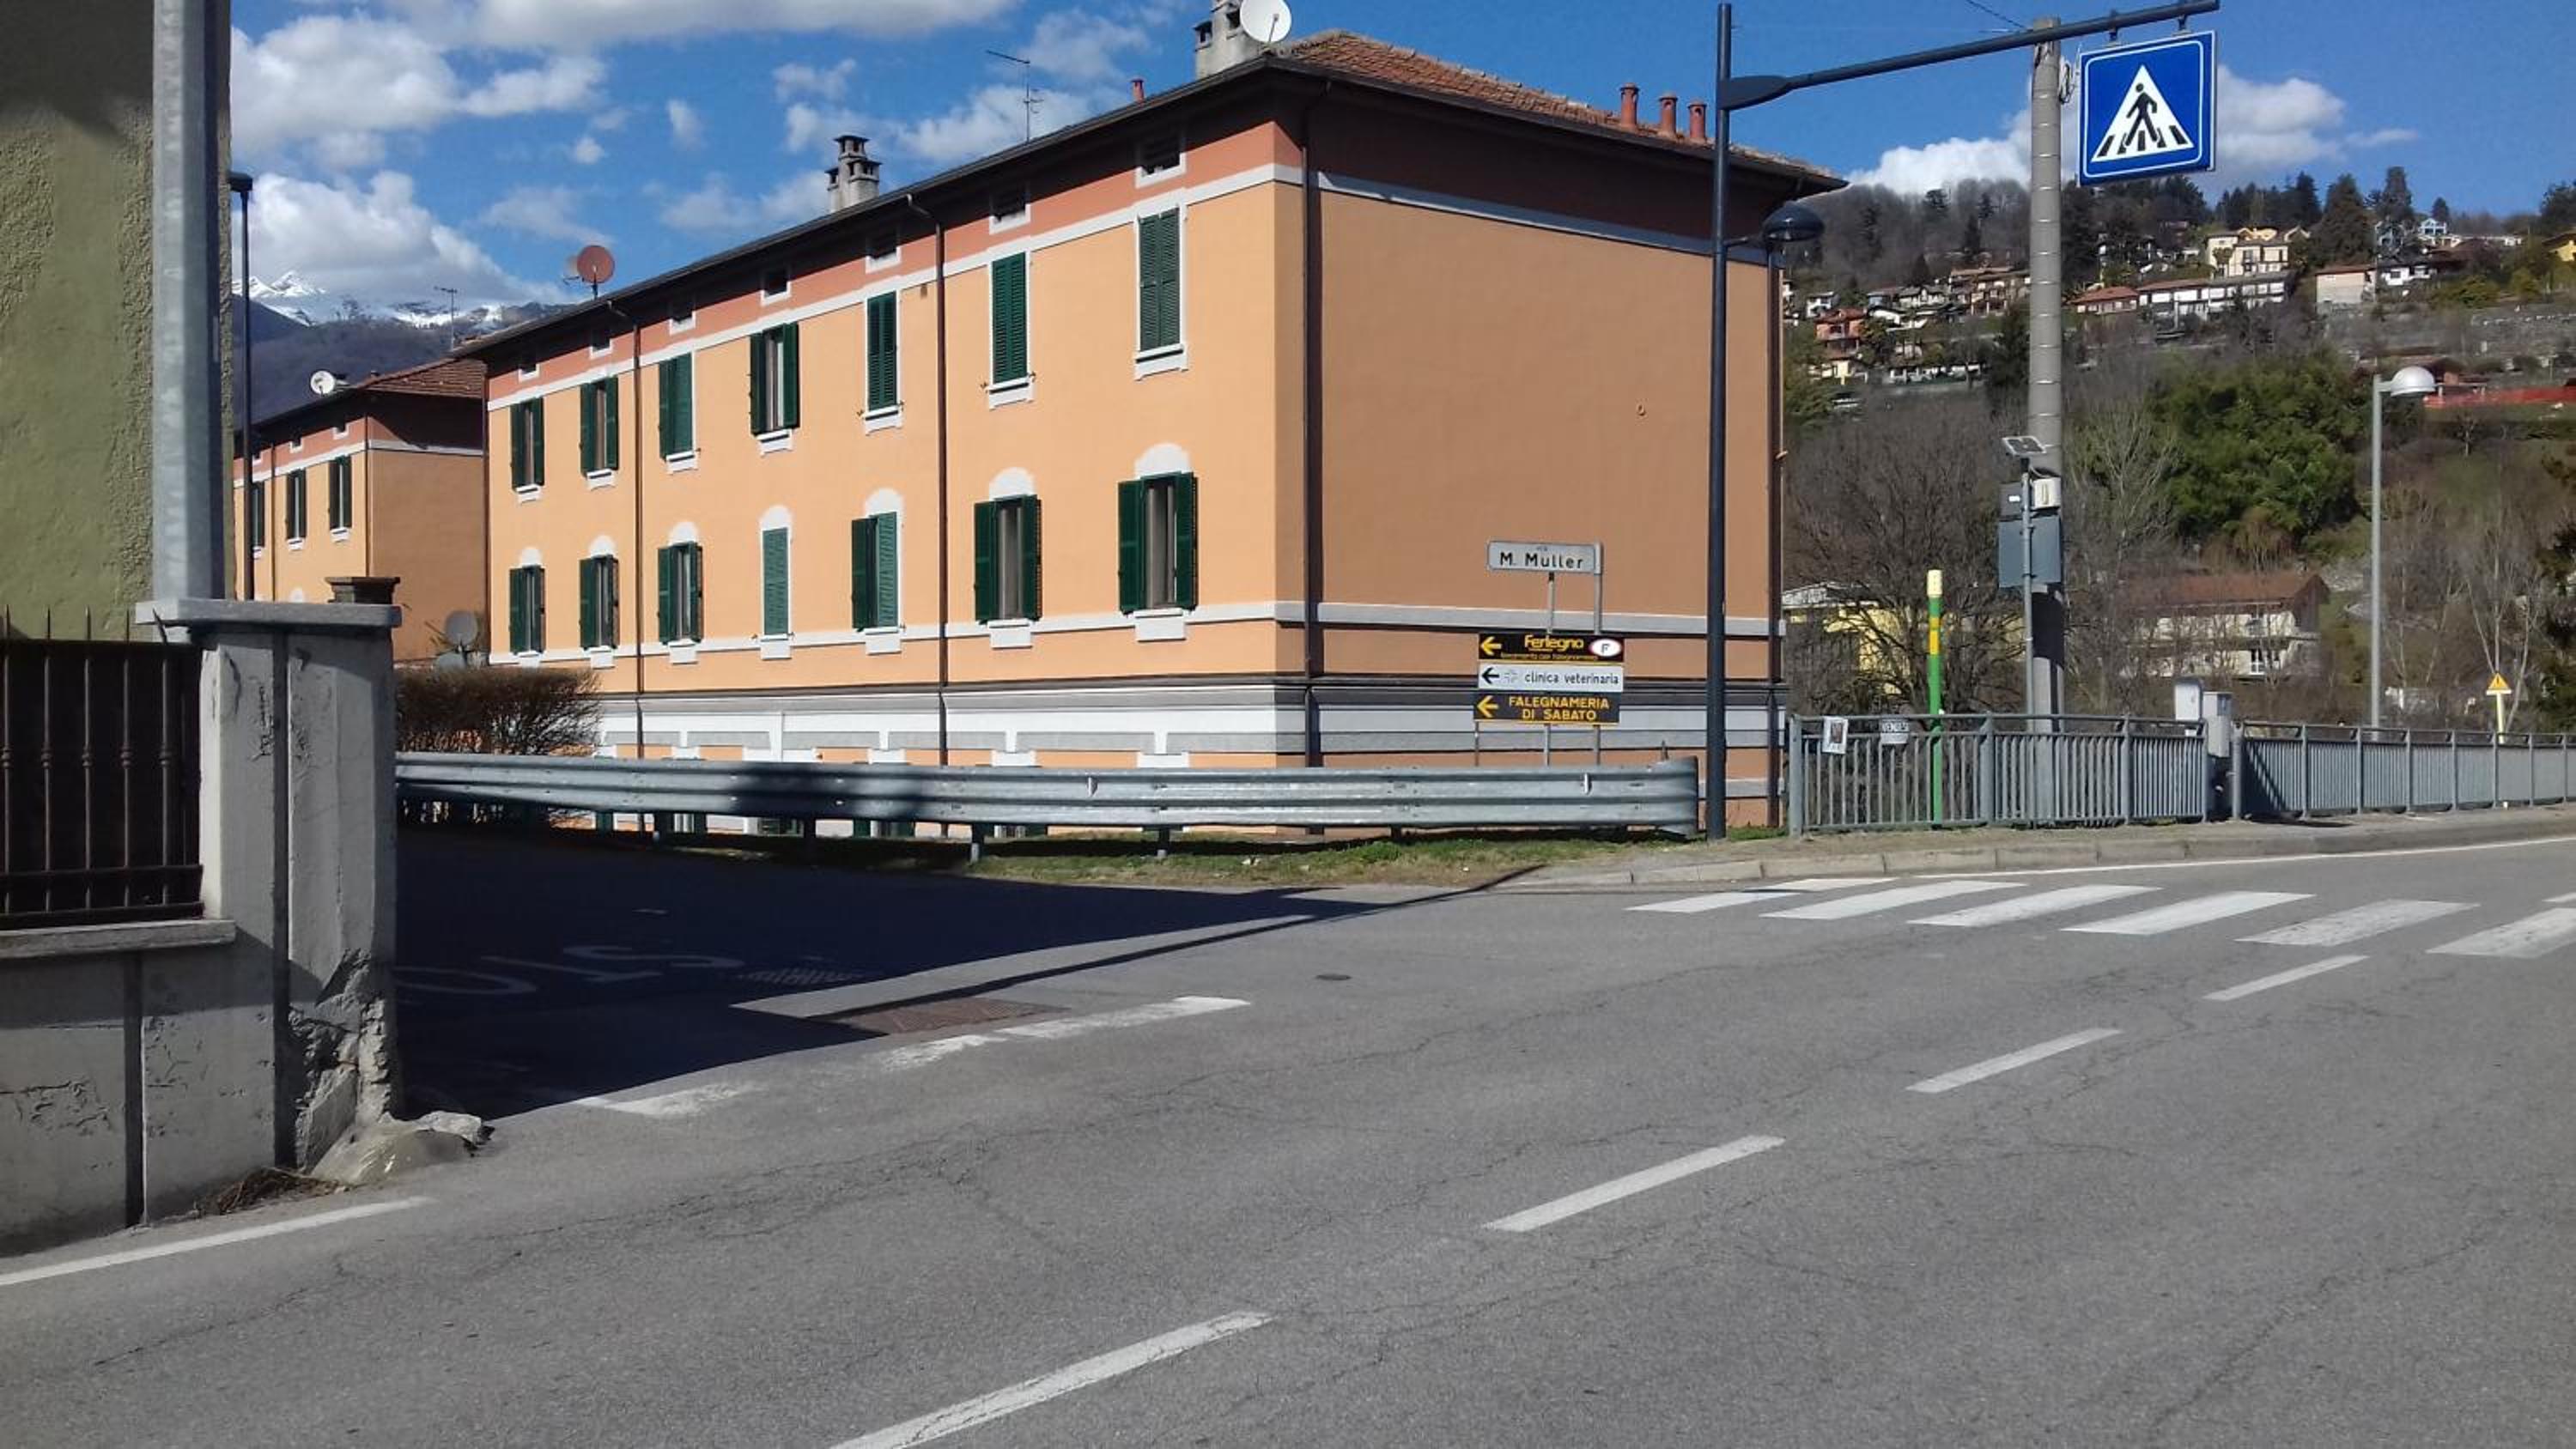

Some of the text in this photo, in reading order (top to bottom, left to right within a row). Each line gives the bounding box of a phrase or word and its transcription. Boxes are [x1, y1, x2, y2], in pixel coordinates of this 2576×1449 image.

[1500, 551, 1516, 567] M.
[1524, 634, 1584, 651] Ferlegno
[1524, 673, 1559, 683] clinica
[1564, 672, 1619, 684] veterinaria
[1509, 696, 1610, 709] FALEGNAMERIA
[1522, 709, 1597, 721] DI SABATO
